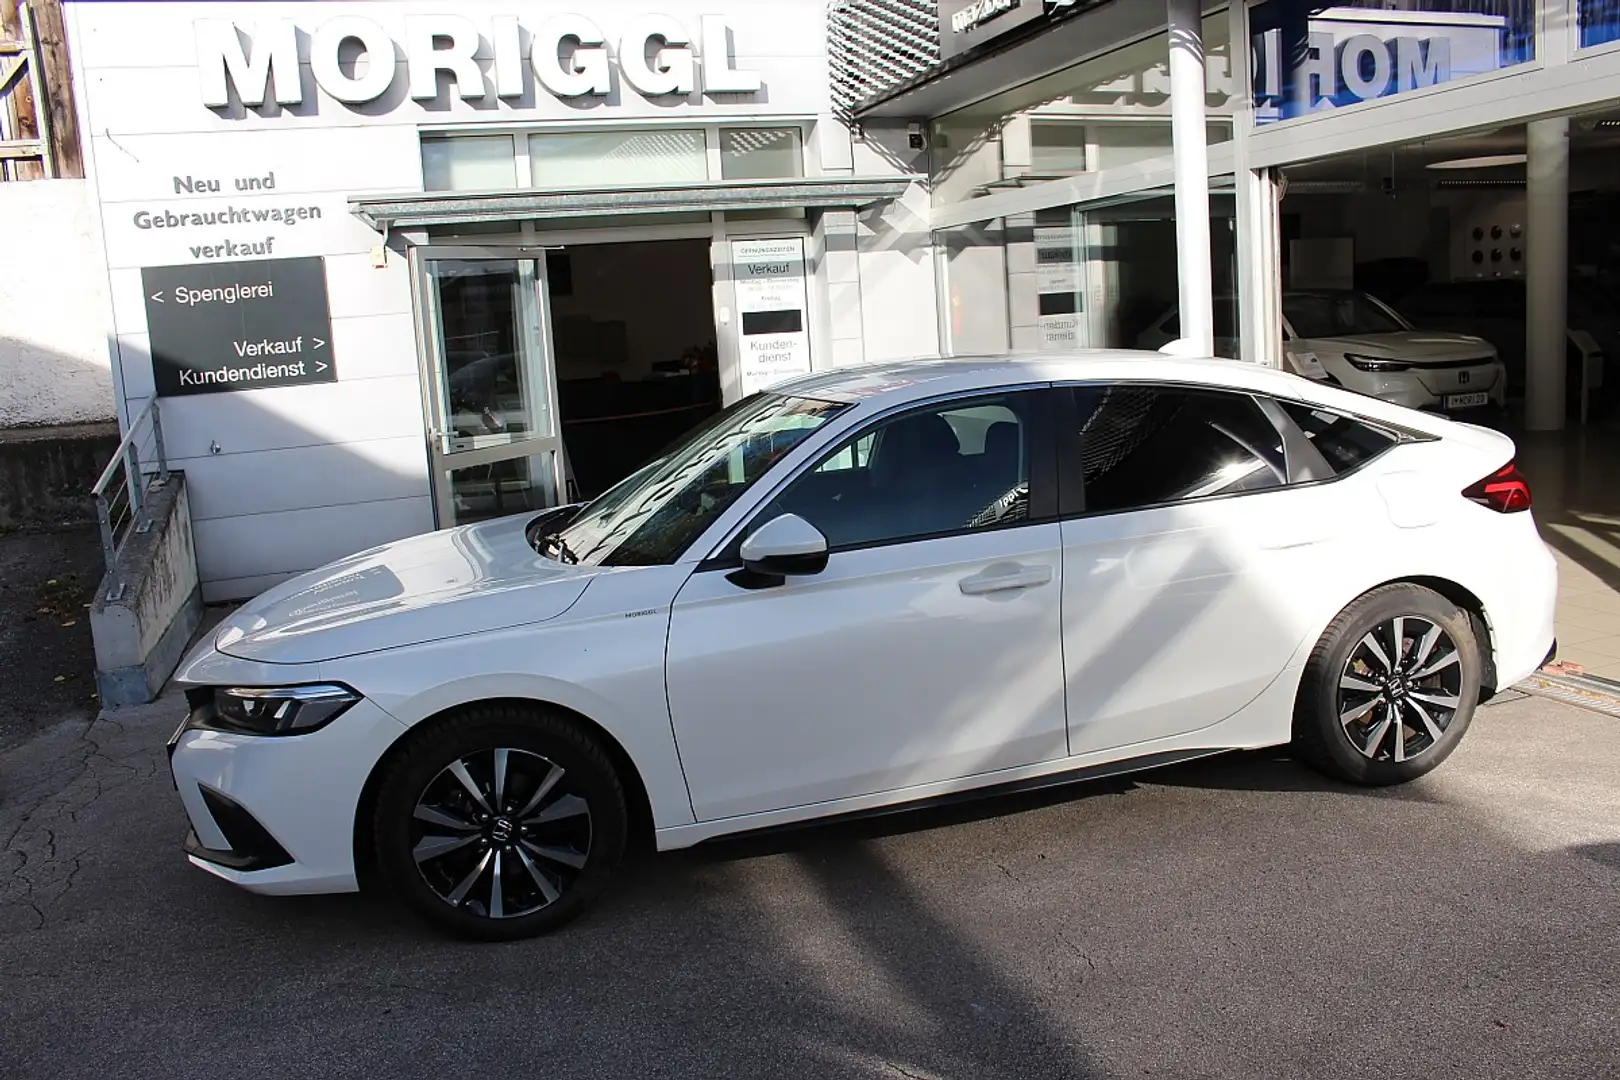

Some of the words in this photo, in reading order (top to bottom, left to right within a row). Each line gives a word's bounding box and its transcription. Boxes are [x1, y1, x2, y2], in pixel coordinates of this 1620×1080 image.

[193, 14, 763, 108] MORIGGL
[173, 175, 220, 194] Neu
[234, 172, 276, 191] und
[133, 206, 322, 229] Gebrauchtwagen
[189, 237, 275, 259] verkauf
[747, 262, 790, 275] Verkauf
[175, 281, 274, 306] Spenglerei
[234, 336, 303, 357] Verkauf
[750, 340, 798, 351] Kunden-
[758, 352, 792, 363] dienst
[179, 362, 306, 386] Kundendienst
